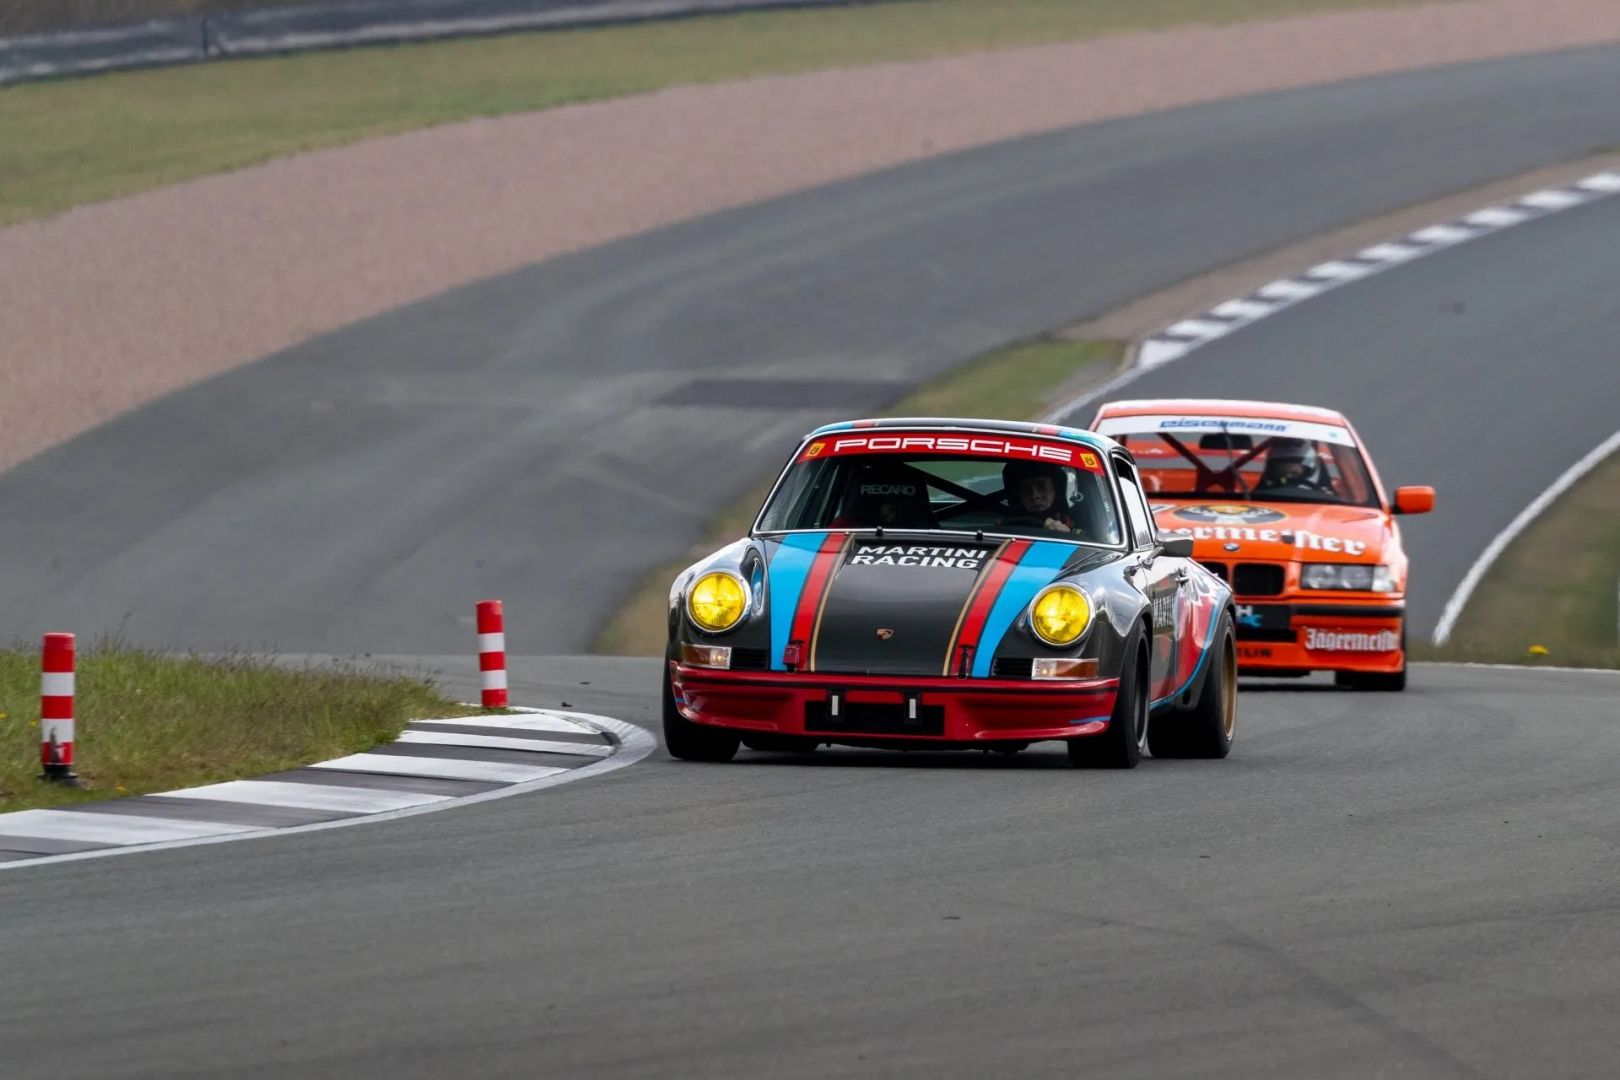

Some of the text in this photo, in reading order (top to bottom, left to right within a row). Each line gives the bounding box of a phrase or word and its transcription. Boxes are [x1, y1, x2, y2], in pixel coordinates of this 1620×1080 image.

[834, 437, 1072, 461] PORSCHE
[861, 484, 915, 495] RECARO
[858, 546, 988, 559] MARTINI
[851, 555, 979, 569] RACING
